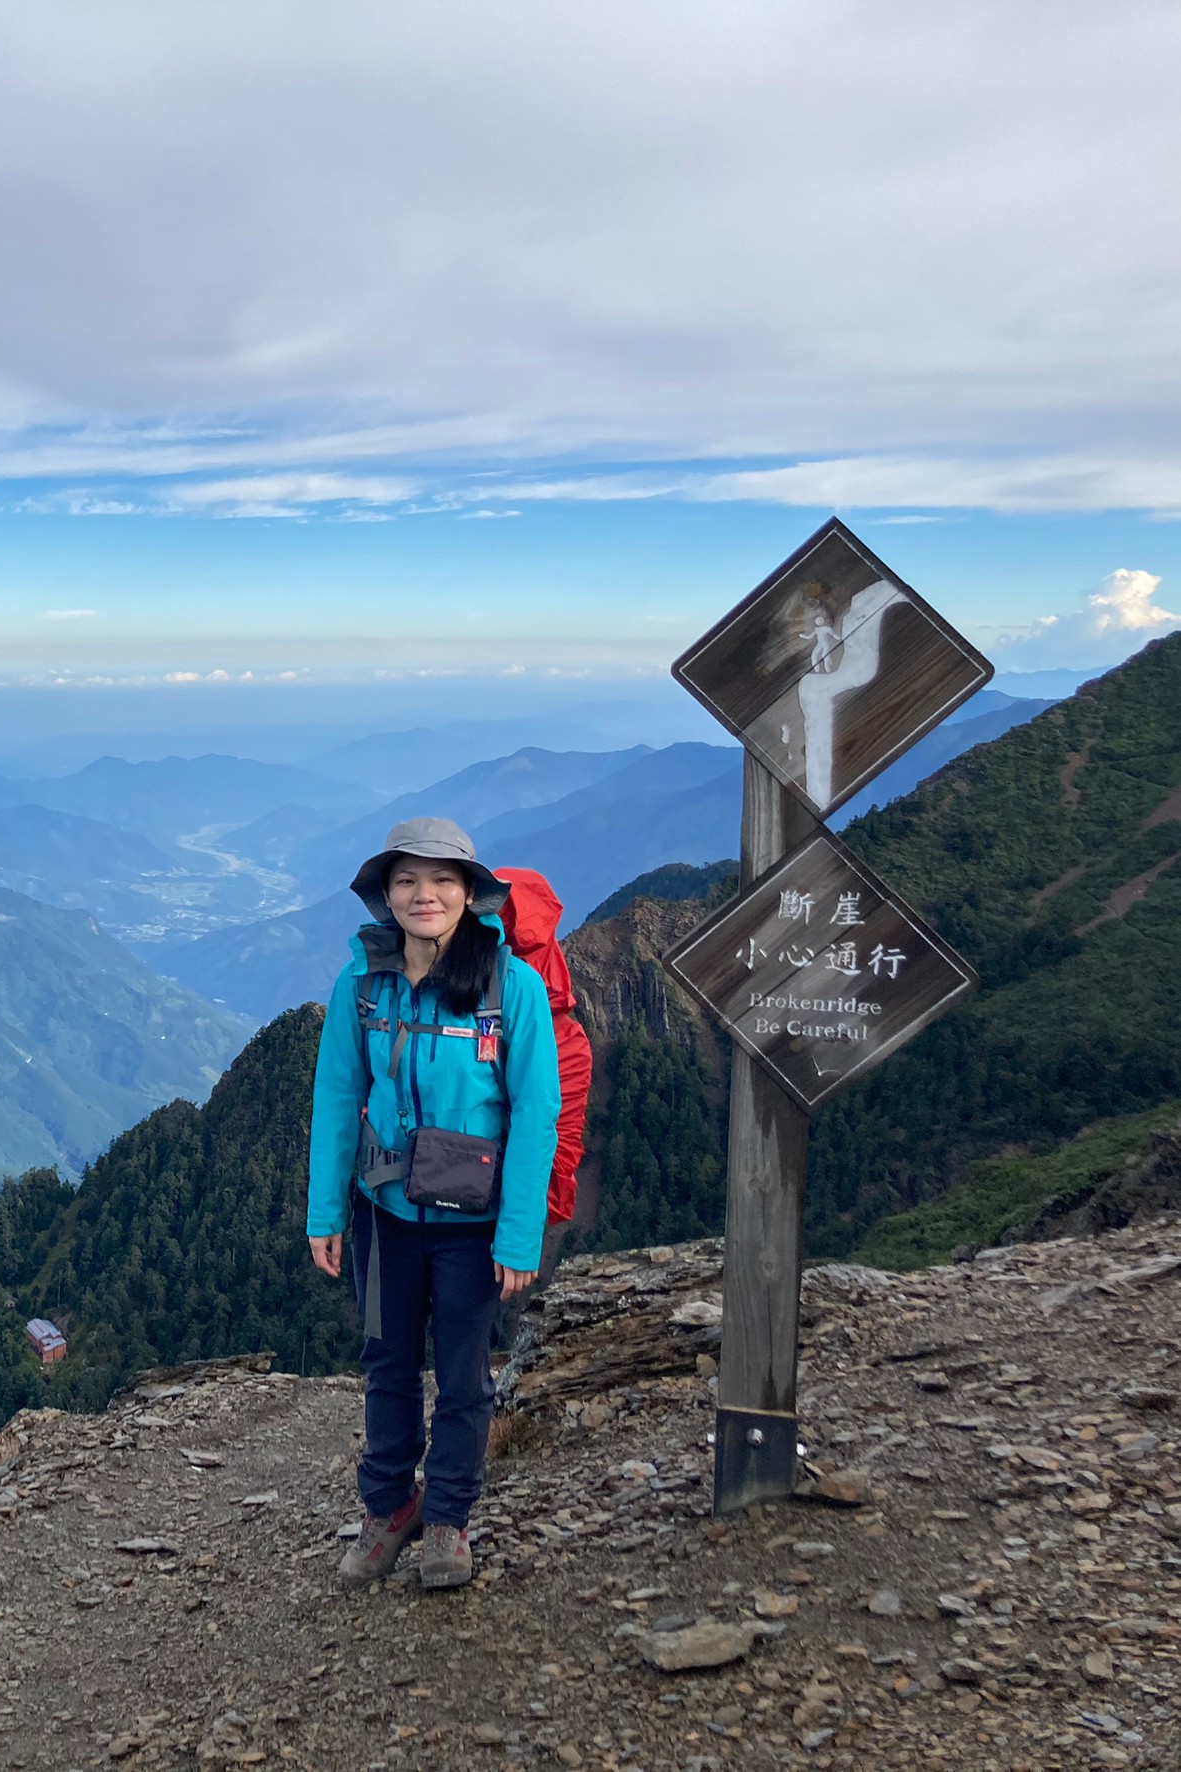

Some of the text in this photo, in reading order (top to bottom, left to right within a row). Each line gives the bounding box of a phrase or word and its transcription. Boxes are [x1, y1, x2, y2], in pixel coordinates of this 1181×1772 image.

[778, 889, 866, 926] 斷崖
[735, 937, 907, 980] 小心通行
[748, 991, 883, 1015] Brokenridge
[754, 1017, 868, 1041] Be Careful
